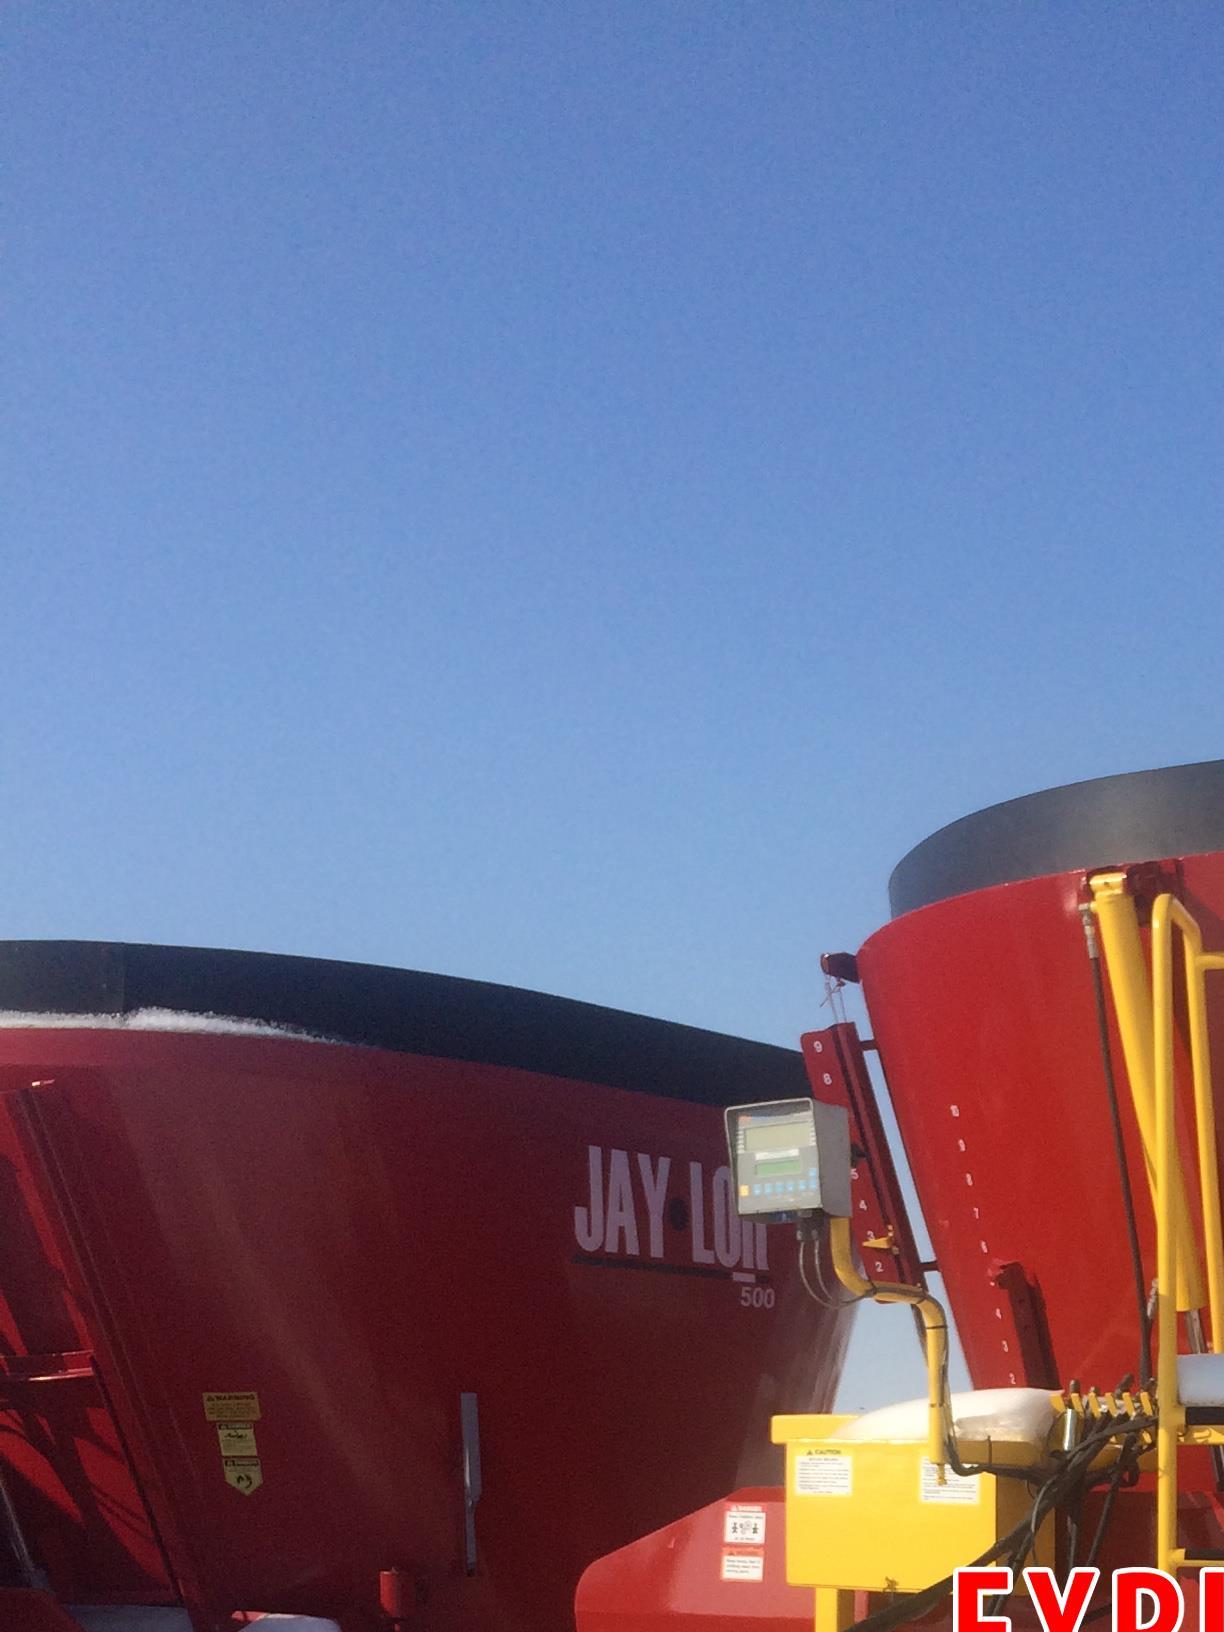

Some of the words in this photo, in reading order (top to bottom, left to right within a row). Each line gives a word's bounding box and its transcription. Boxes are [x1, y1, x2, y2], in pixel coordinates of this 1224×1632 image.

[813, 1040, 823, 1053] 9
[823, 1073, 832, 1085] 8
[574, 1145, 671, 1258] JAY
[859, 1200, 868, 1211] 4
[875, 1261, 884, 1272] 2
[740, 1287, 775, 1309] 500
